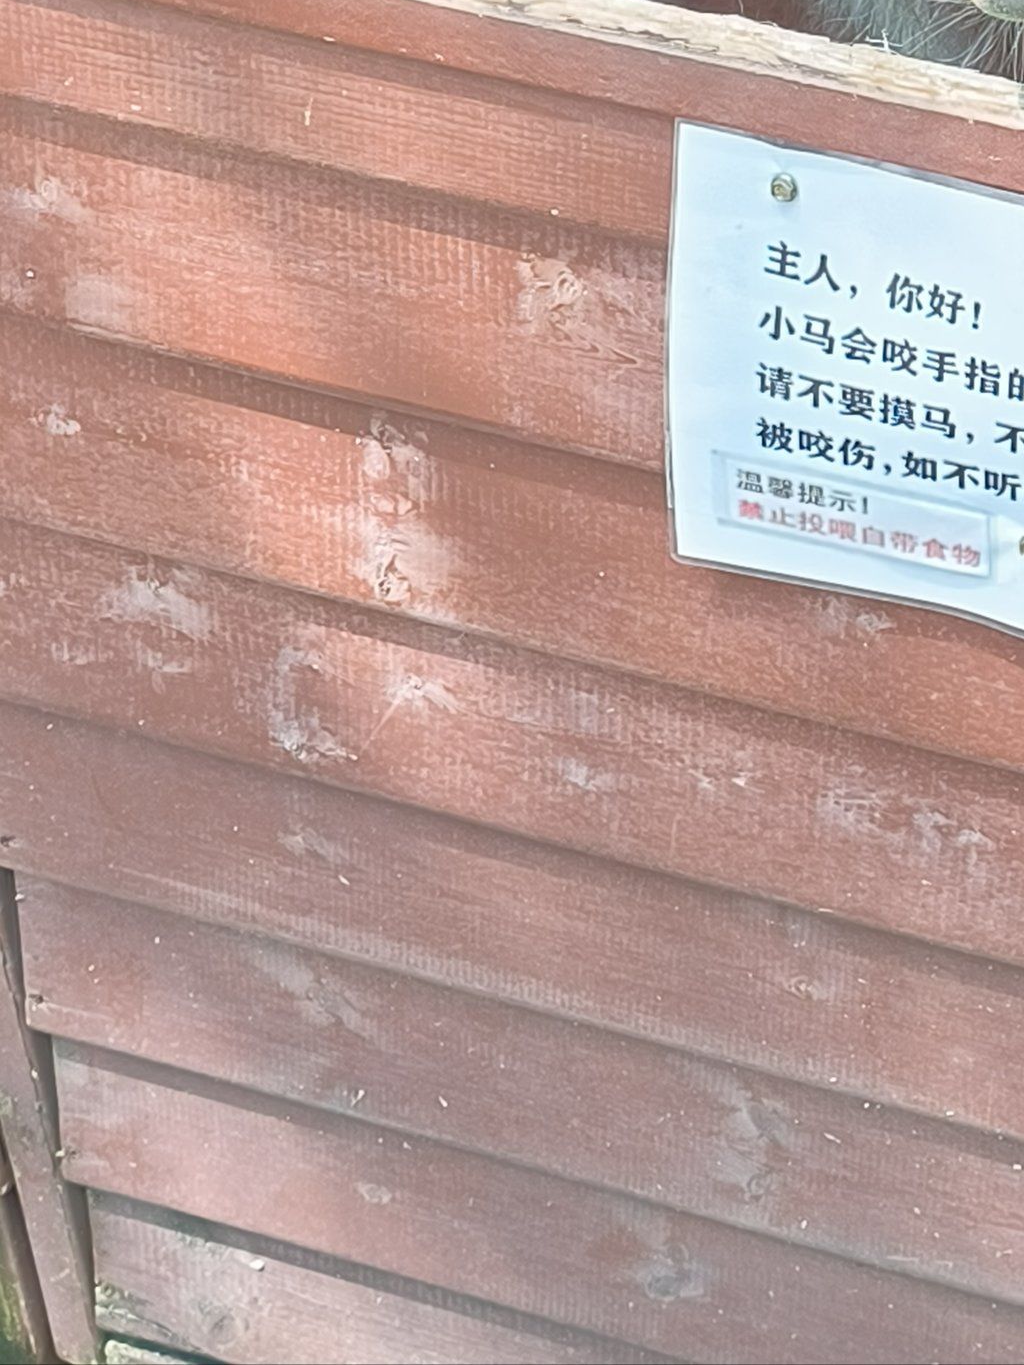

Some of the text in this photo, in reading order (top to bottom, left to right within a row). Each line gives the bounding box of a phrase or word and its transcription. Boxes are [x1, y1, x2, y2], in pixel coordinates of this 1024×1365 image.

[763, 240, 981, 330] 主人，你好！
[737, 499, 981, 568] 禁止投喂自带食物
